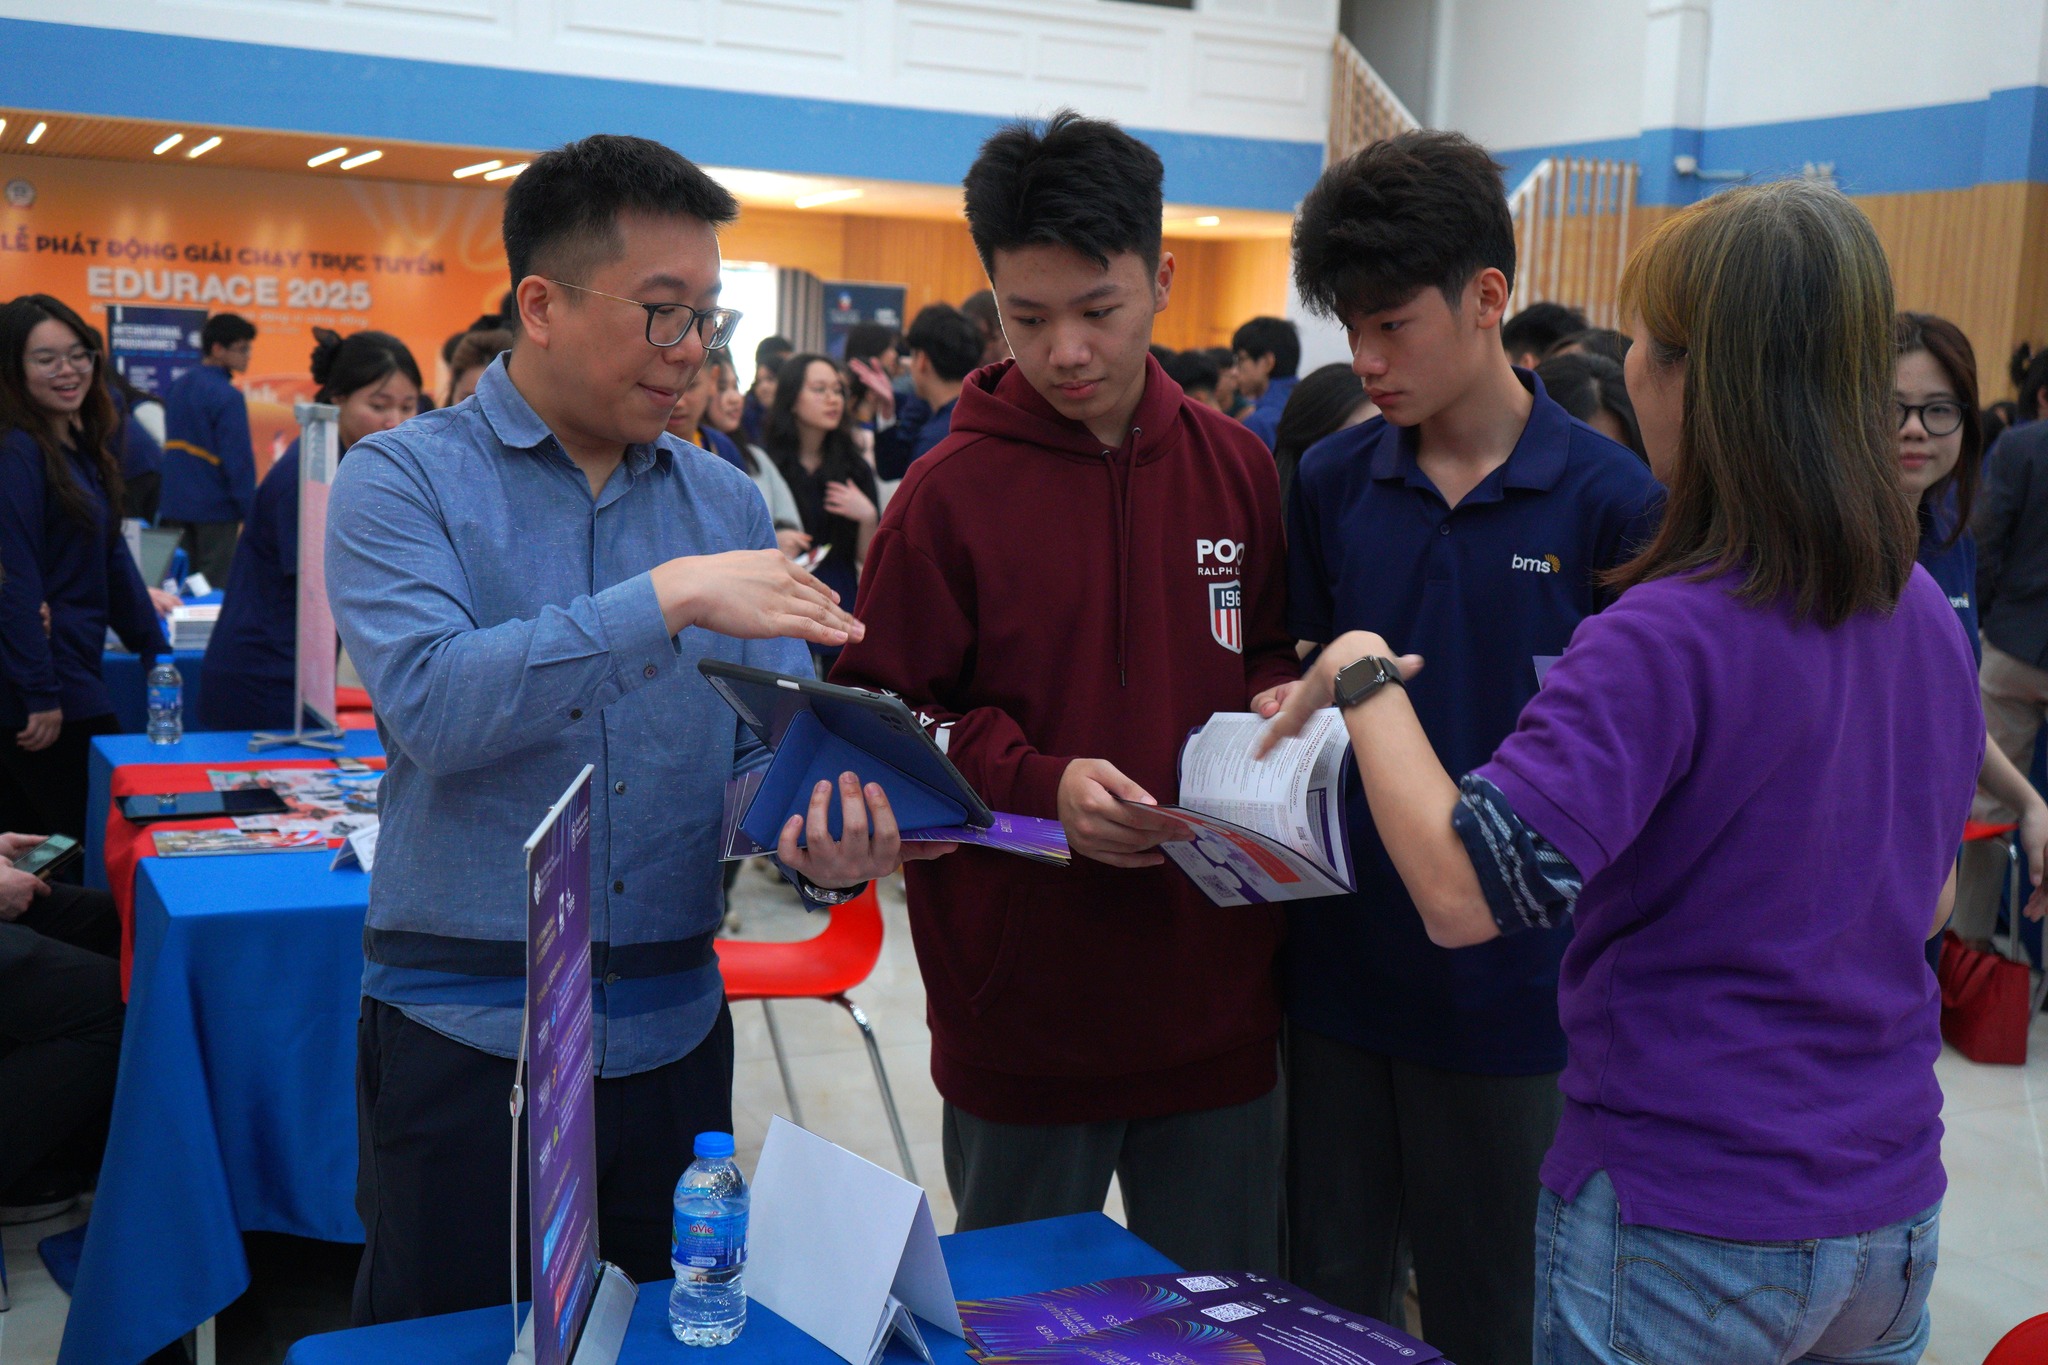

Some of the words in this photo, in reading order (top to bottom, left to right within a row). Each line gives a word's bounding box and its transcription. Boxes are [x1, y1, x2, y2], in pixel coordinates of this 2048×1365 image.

[36, 232, 100, 256] PHÁT
[107, 237, 178, 264] ĐỘNG
[86, 265, 279, 308] EDURACE
[287, 278, 373, 310] 2025
[1197, 567, 1233, 576] RALPH
[1511, 553, 1551, 574] bms
[1221, 590, 1241, 607] 196
[1035, 1324, 1059, 1344] OVER
